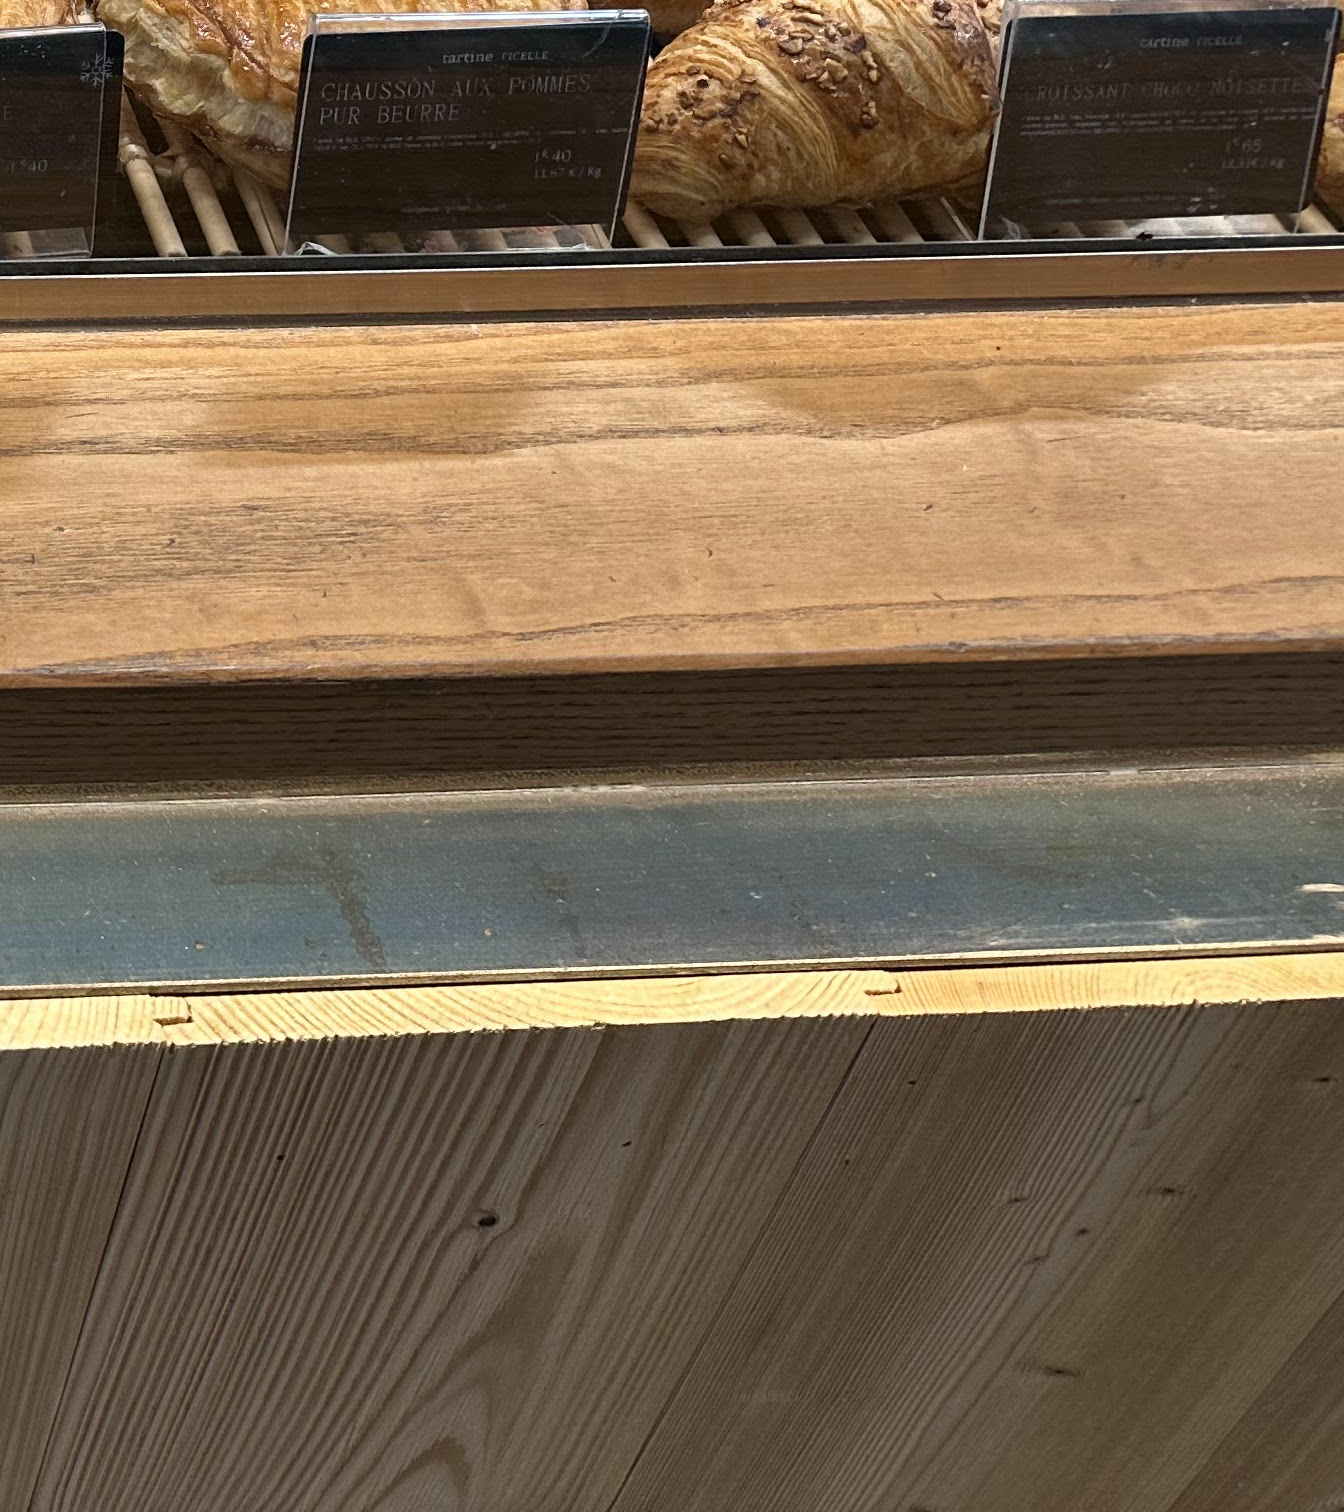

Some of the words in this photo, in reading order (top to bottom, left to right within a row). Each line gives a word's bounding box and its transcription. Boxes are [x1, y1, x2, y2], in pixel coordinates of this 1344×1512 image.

[320, 79, 436, 102] CHAUSSON
[451, 76, 493, 98] AUX
[508, 73, 593, 96] POMMES
[1025, 82, 1131, 101] CROISSANT
[1211, 76, 1311, 96] NOISETTE
[318, 105, 361, 126] PUR
[376, 103, 462, 125] BEURRE
